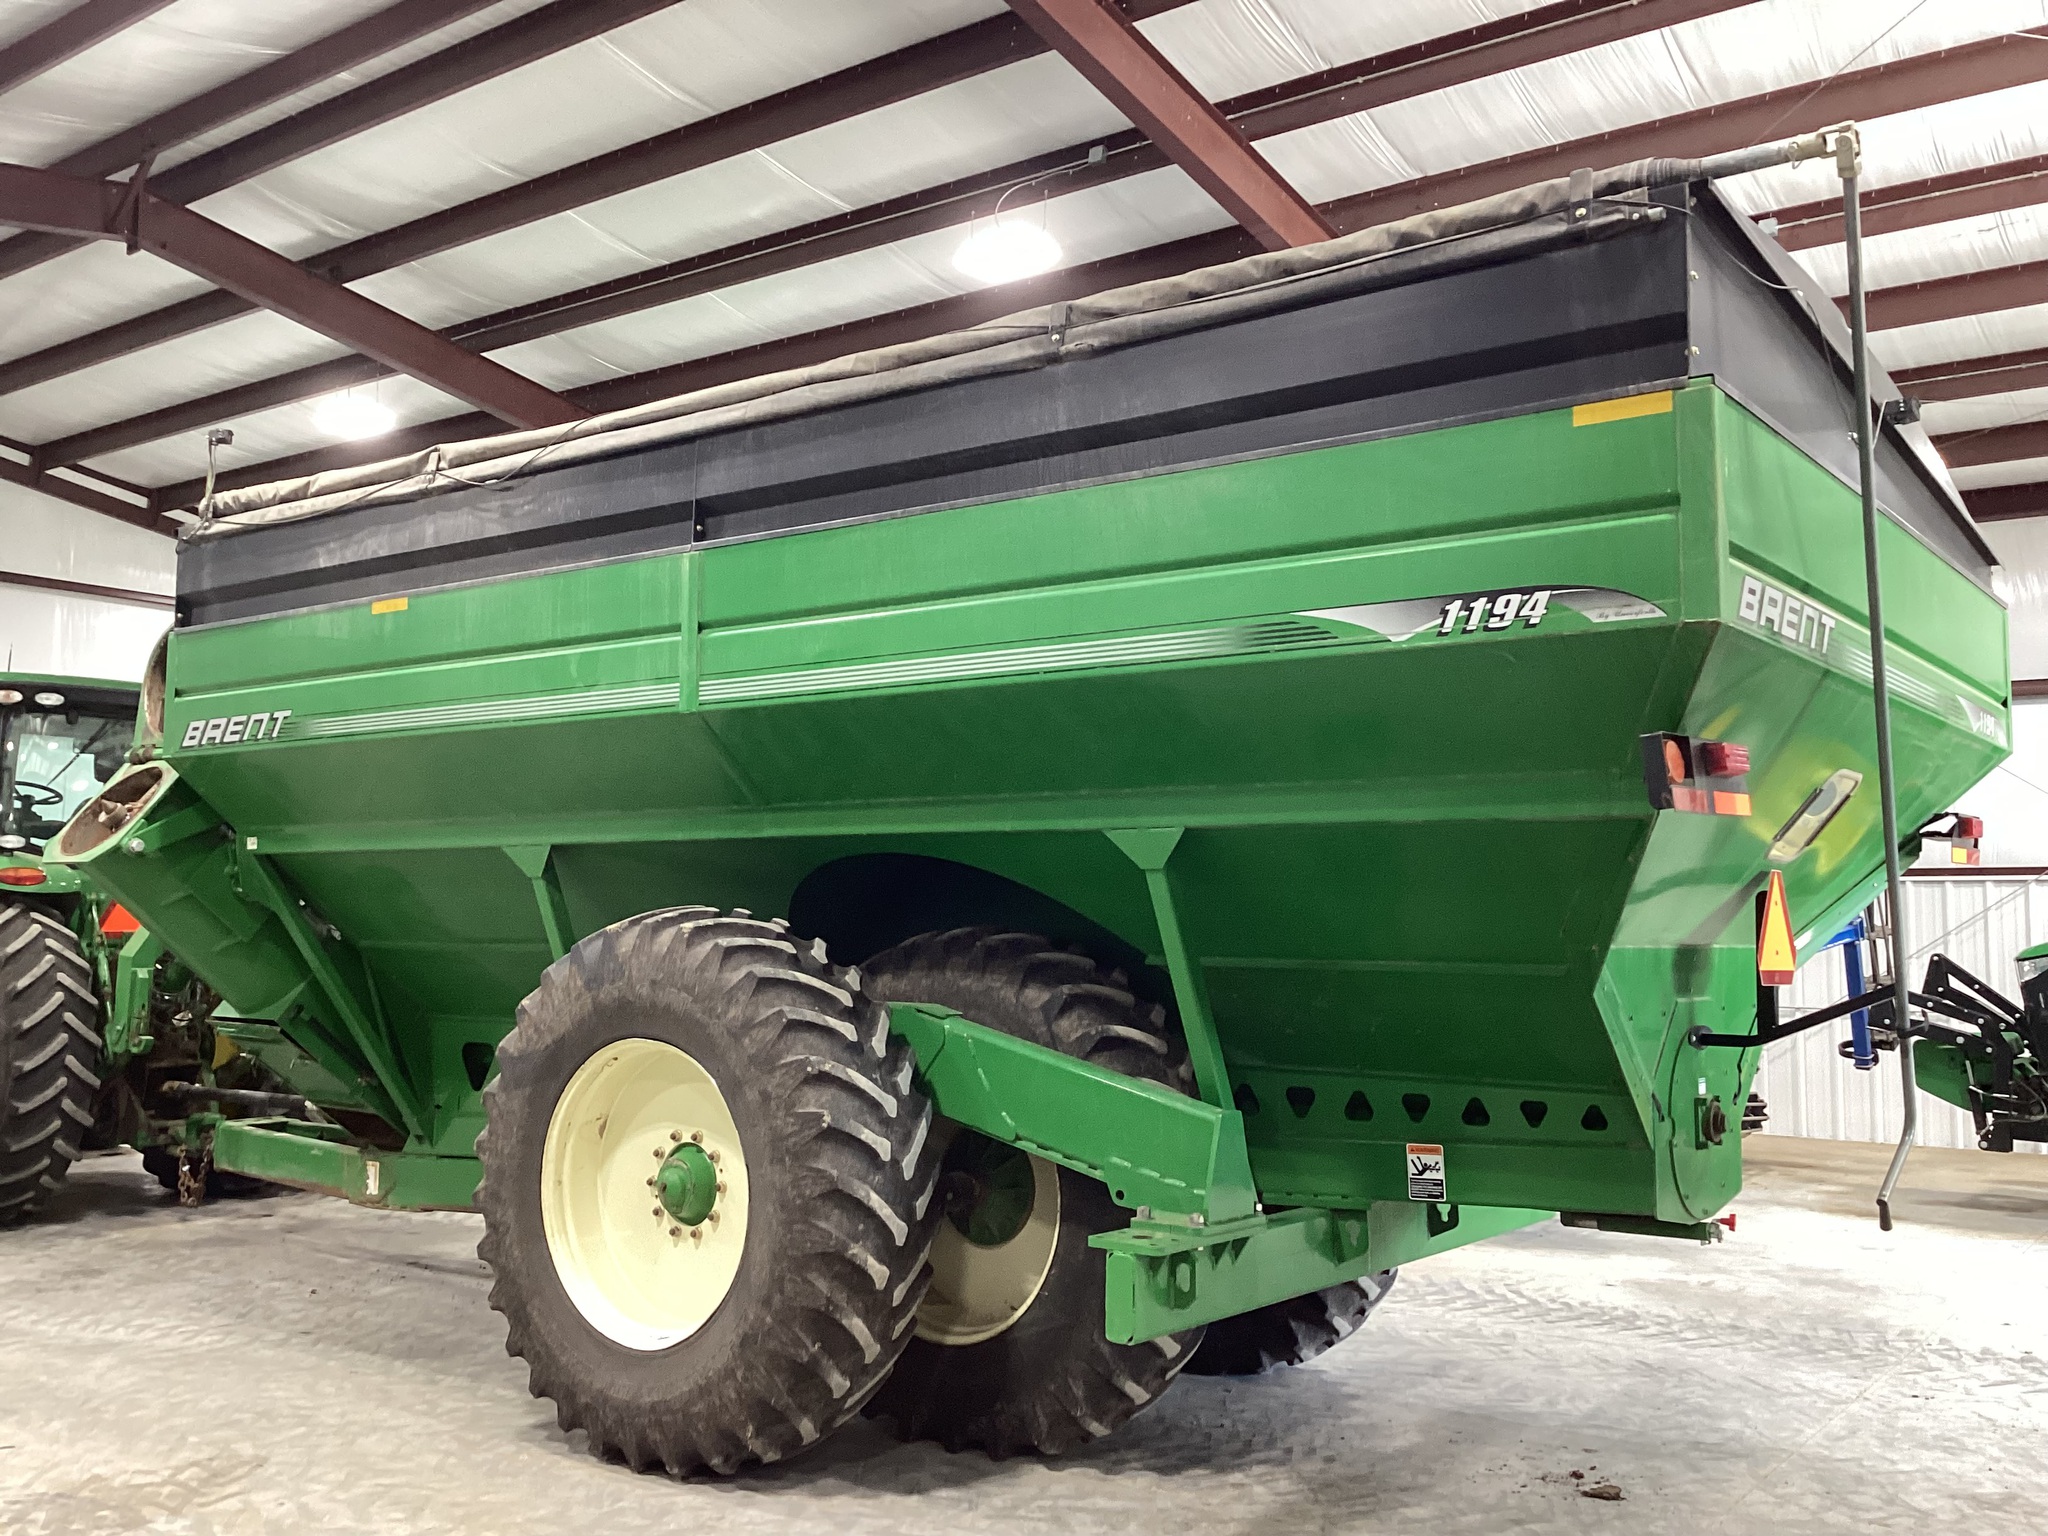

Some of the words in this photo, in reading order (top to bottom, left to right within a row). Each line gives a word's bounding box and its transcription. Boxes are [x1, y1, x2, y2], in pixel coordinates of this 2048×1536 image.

[1437, 590, 1553, 636] 1194
[1739, 574, 1836, 654] BRENT
[181, 709, 293, 748] BRENT
